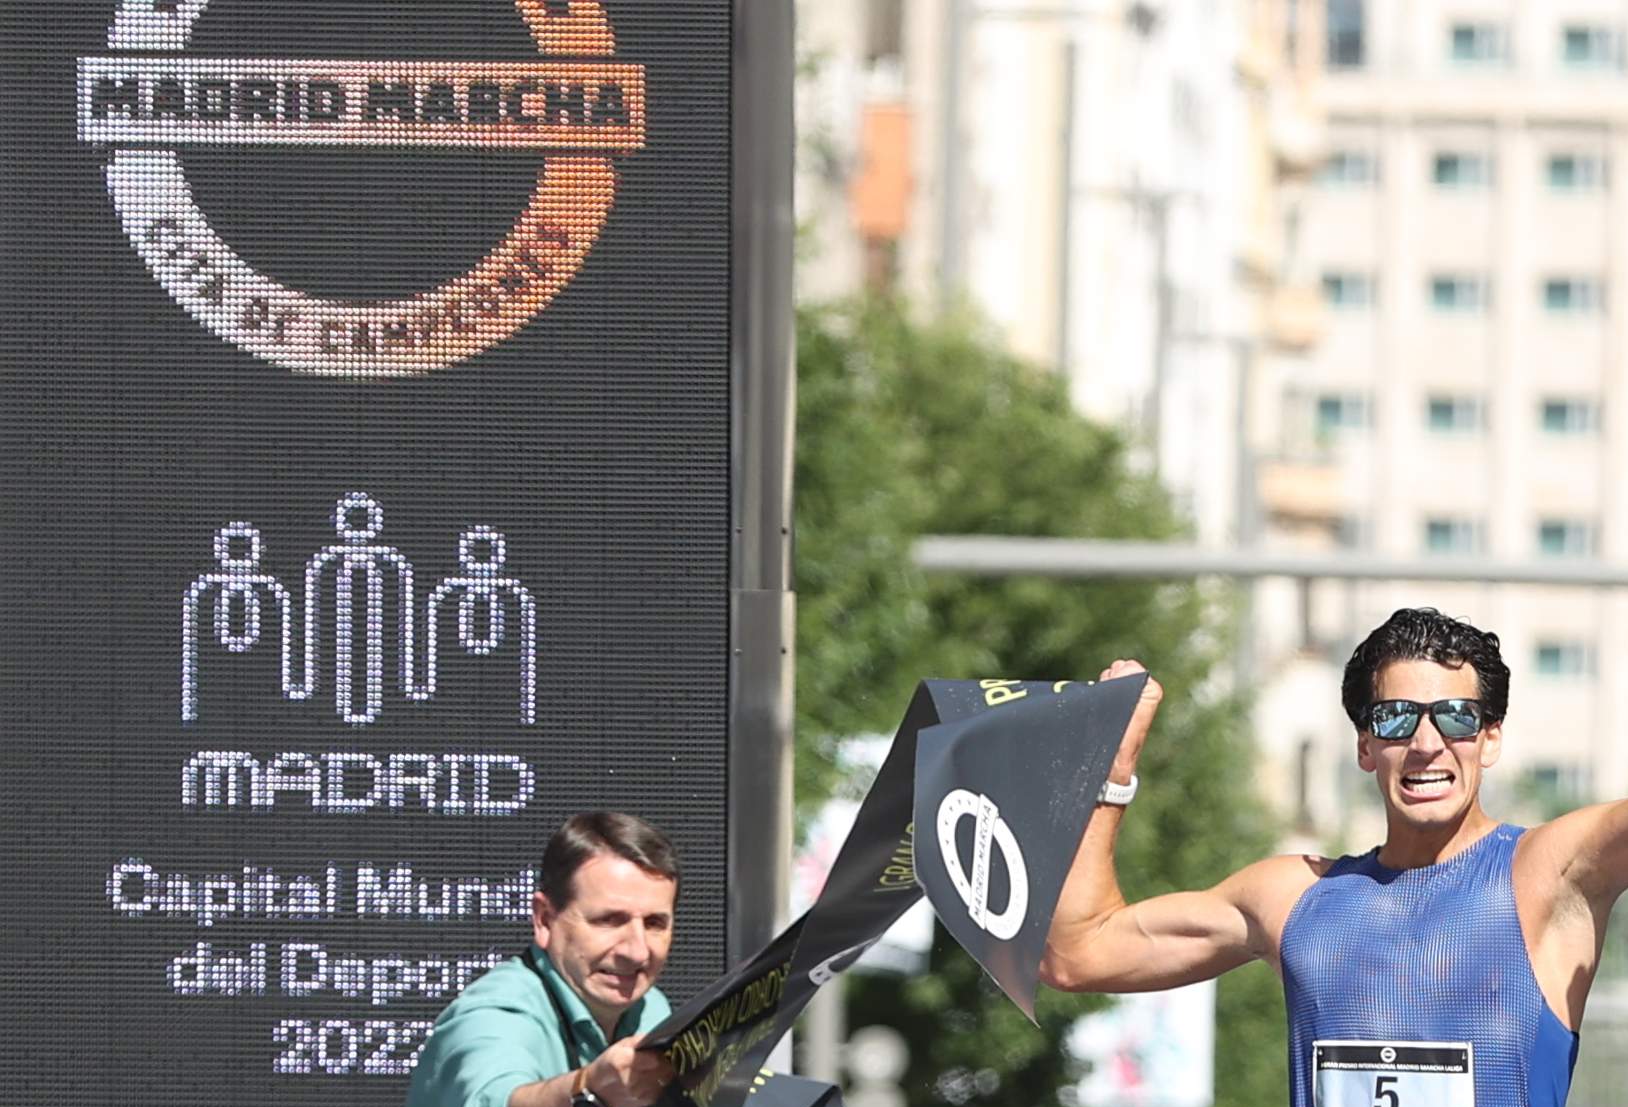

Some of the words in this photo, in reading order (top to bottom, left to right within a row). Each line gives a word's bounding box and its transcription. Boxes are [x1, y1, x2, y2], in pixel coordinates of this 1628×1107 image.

[92, 73, 346, 123] MADRID
[361, 77, 631, 127] MARCHA
[239, 295, 300, 348] DE
[181, 749, 537, 815] MADRID
[106, 858, 340, 926] Capital
[355, 862, 538, 921] Mund
[167, 941, 268, 996] del
